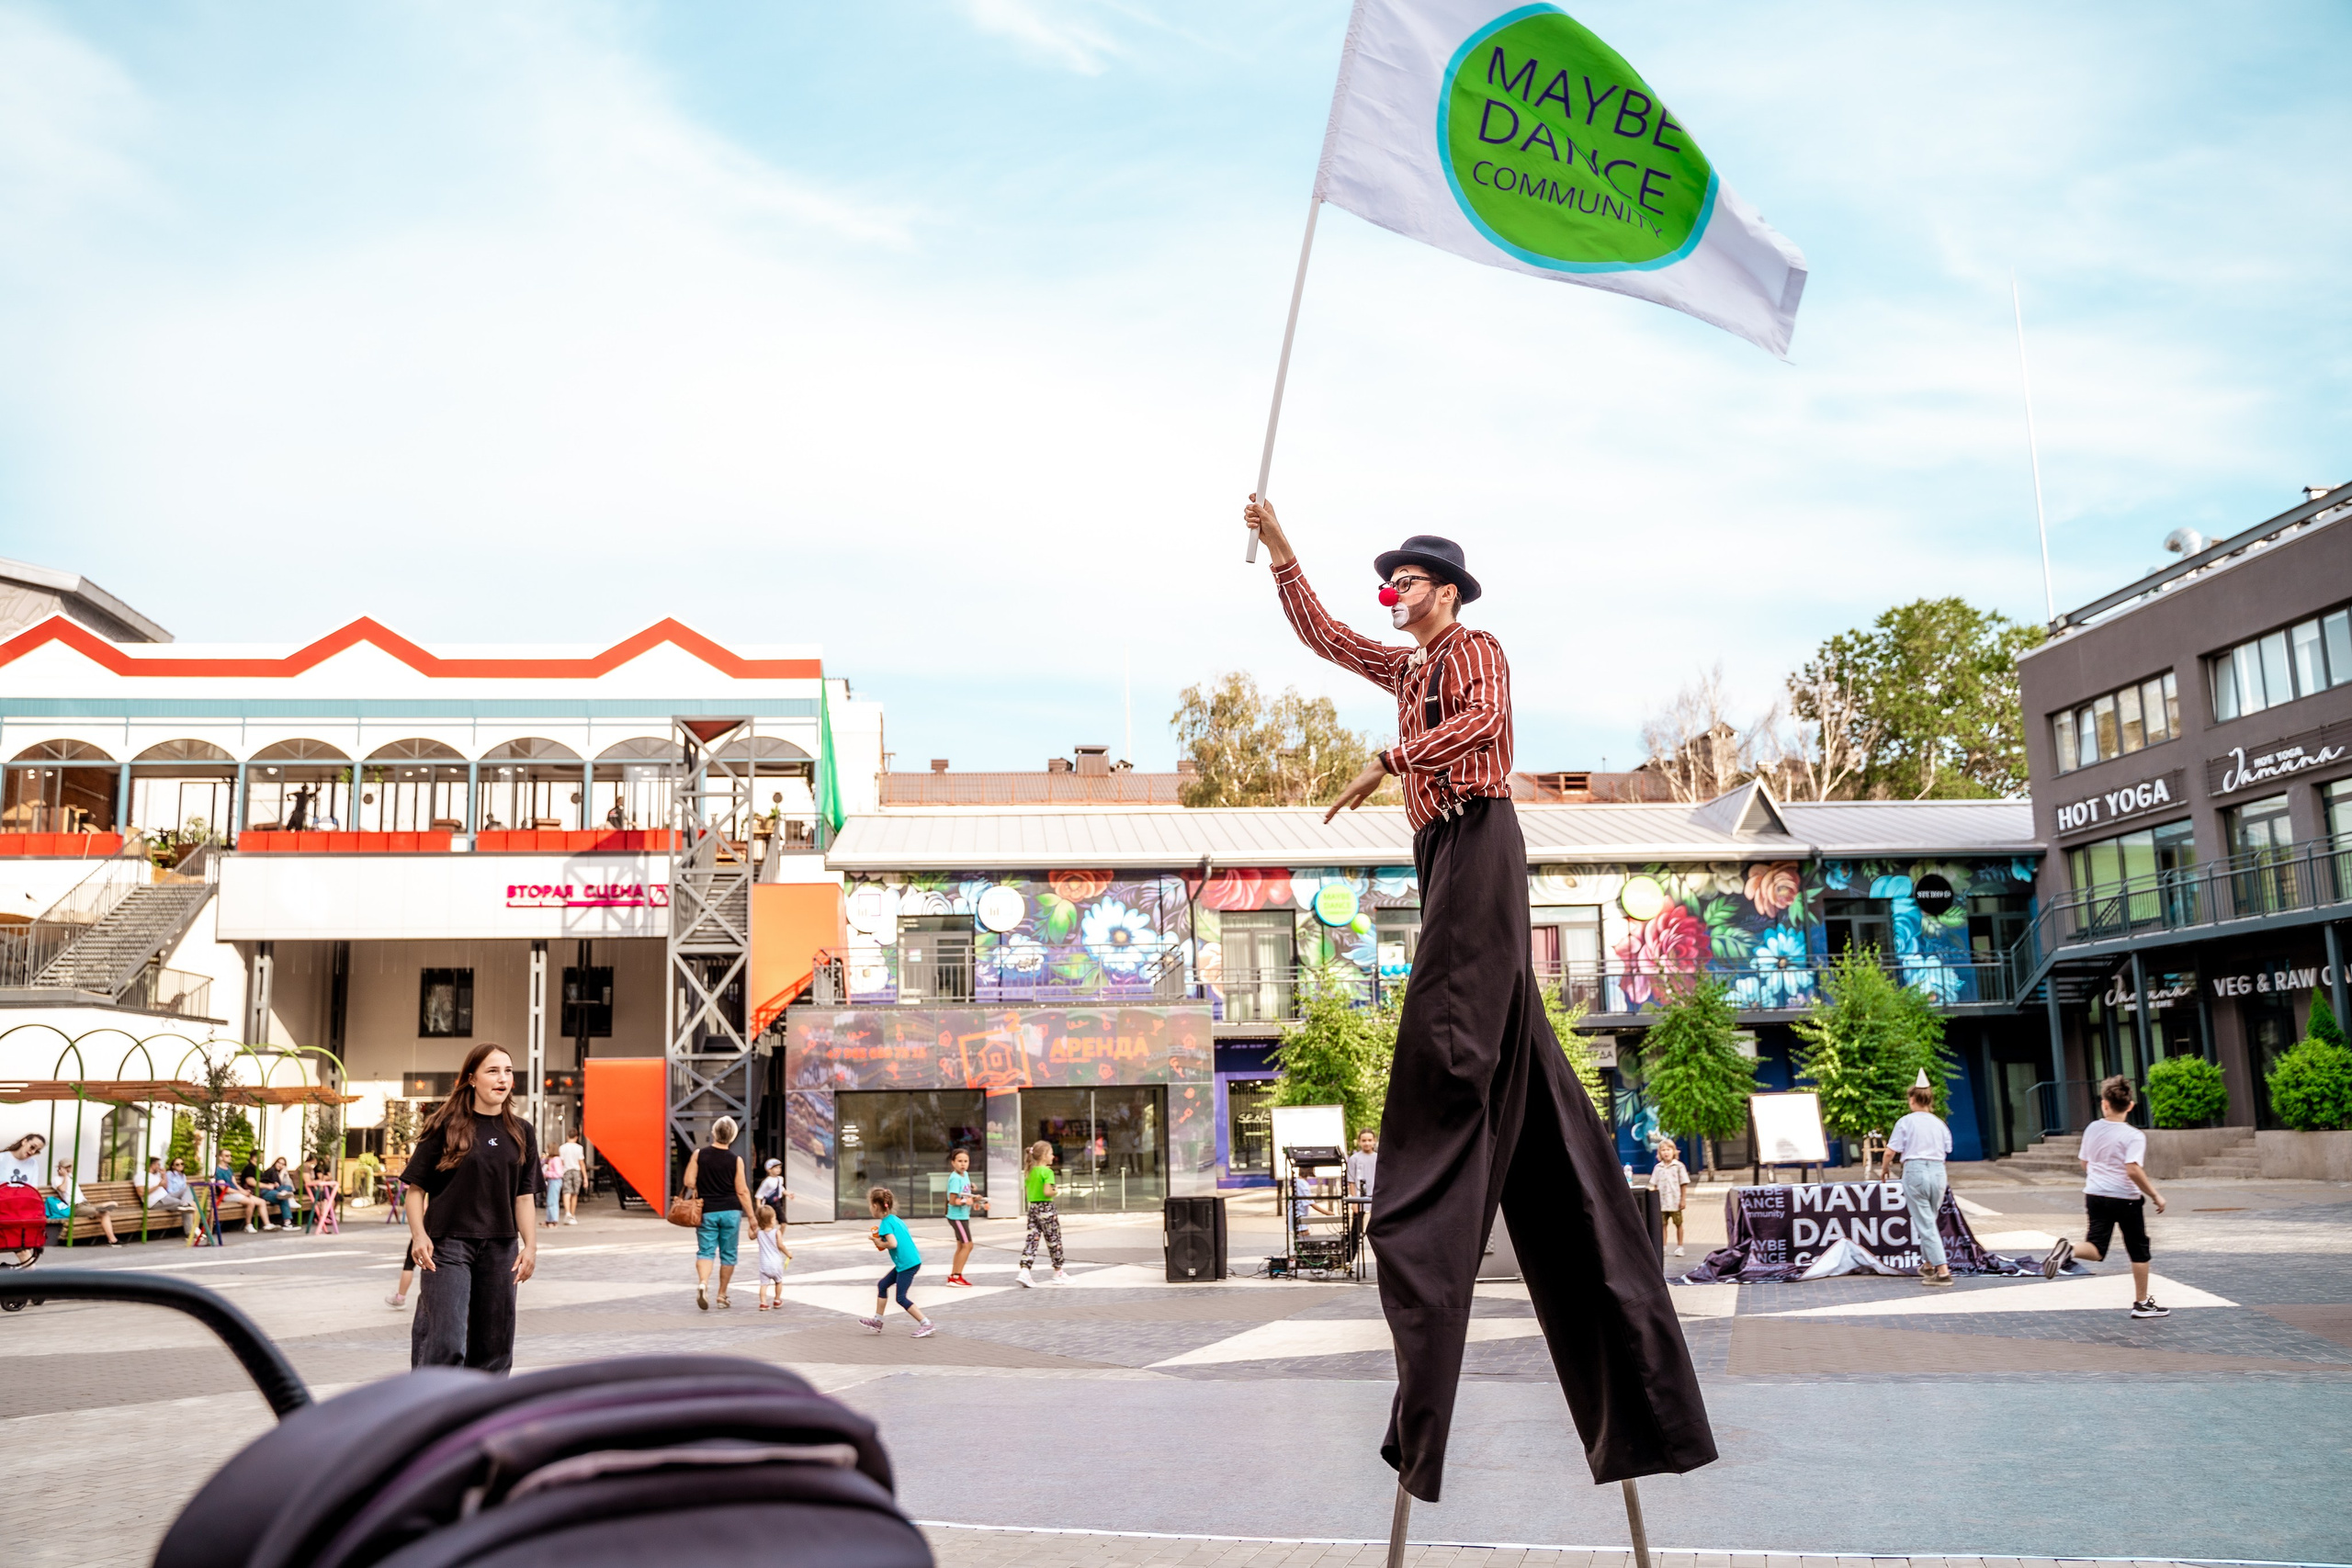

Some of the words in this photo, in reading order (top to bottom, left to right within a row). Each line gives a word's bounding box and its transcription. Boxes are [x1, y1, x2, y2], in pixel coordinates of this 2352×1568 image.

[1487, 46, 1682, 153] MAYBE
[1478, 98, 1672, 216] DANCE
[1473, 161, 1664, 239] COMMUNITY
[2222, 747, 2346, 794] Jamuna
[2058, 797, 2101, 831] HOT
[2104, 778, 2171, 817] YOGA
[506, 885, 573, 898] ВТОРАЯ
[583, 884, 644, 899] СЦЕНА
[2212, 975, 2253, 998] VEG
[2256, 973, 2271, 993] &
[2274, 967, 2318, 991] RAW
[1744, 1197, 1785, 1209] ANCE
[1792, 1182, 1907, 1213] MAYB
[1747, 1252, 1787, 1264] ANCE
[1749, 1239, 1787, 1251] AYBE
